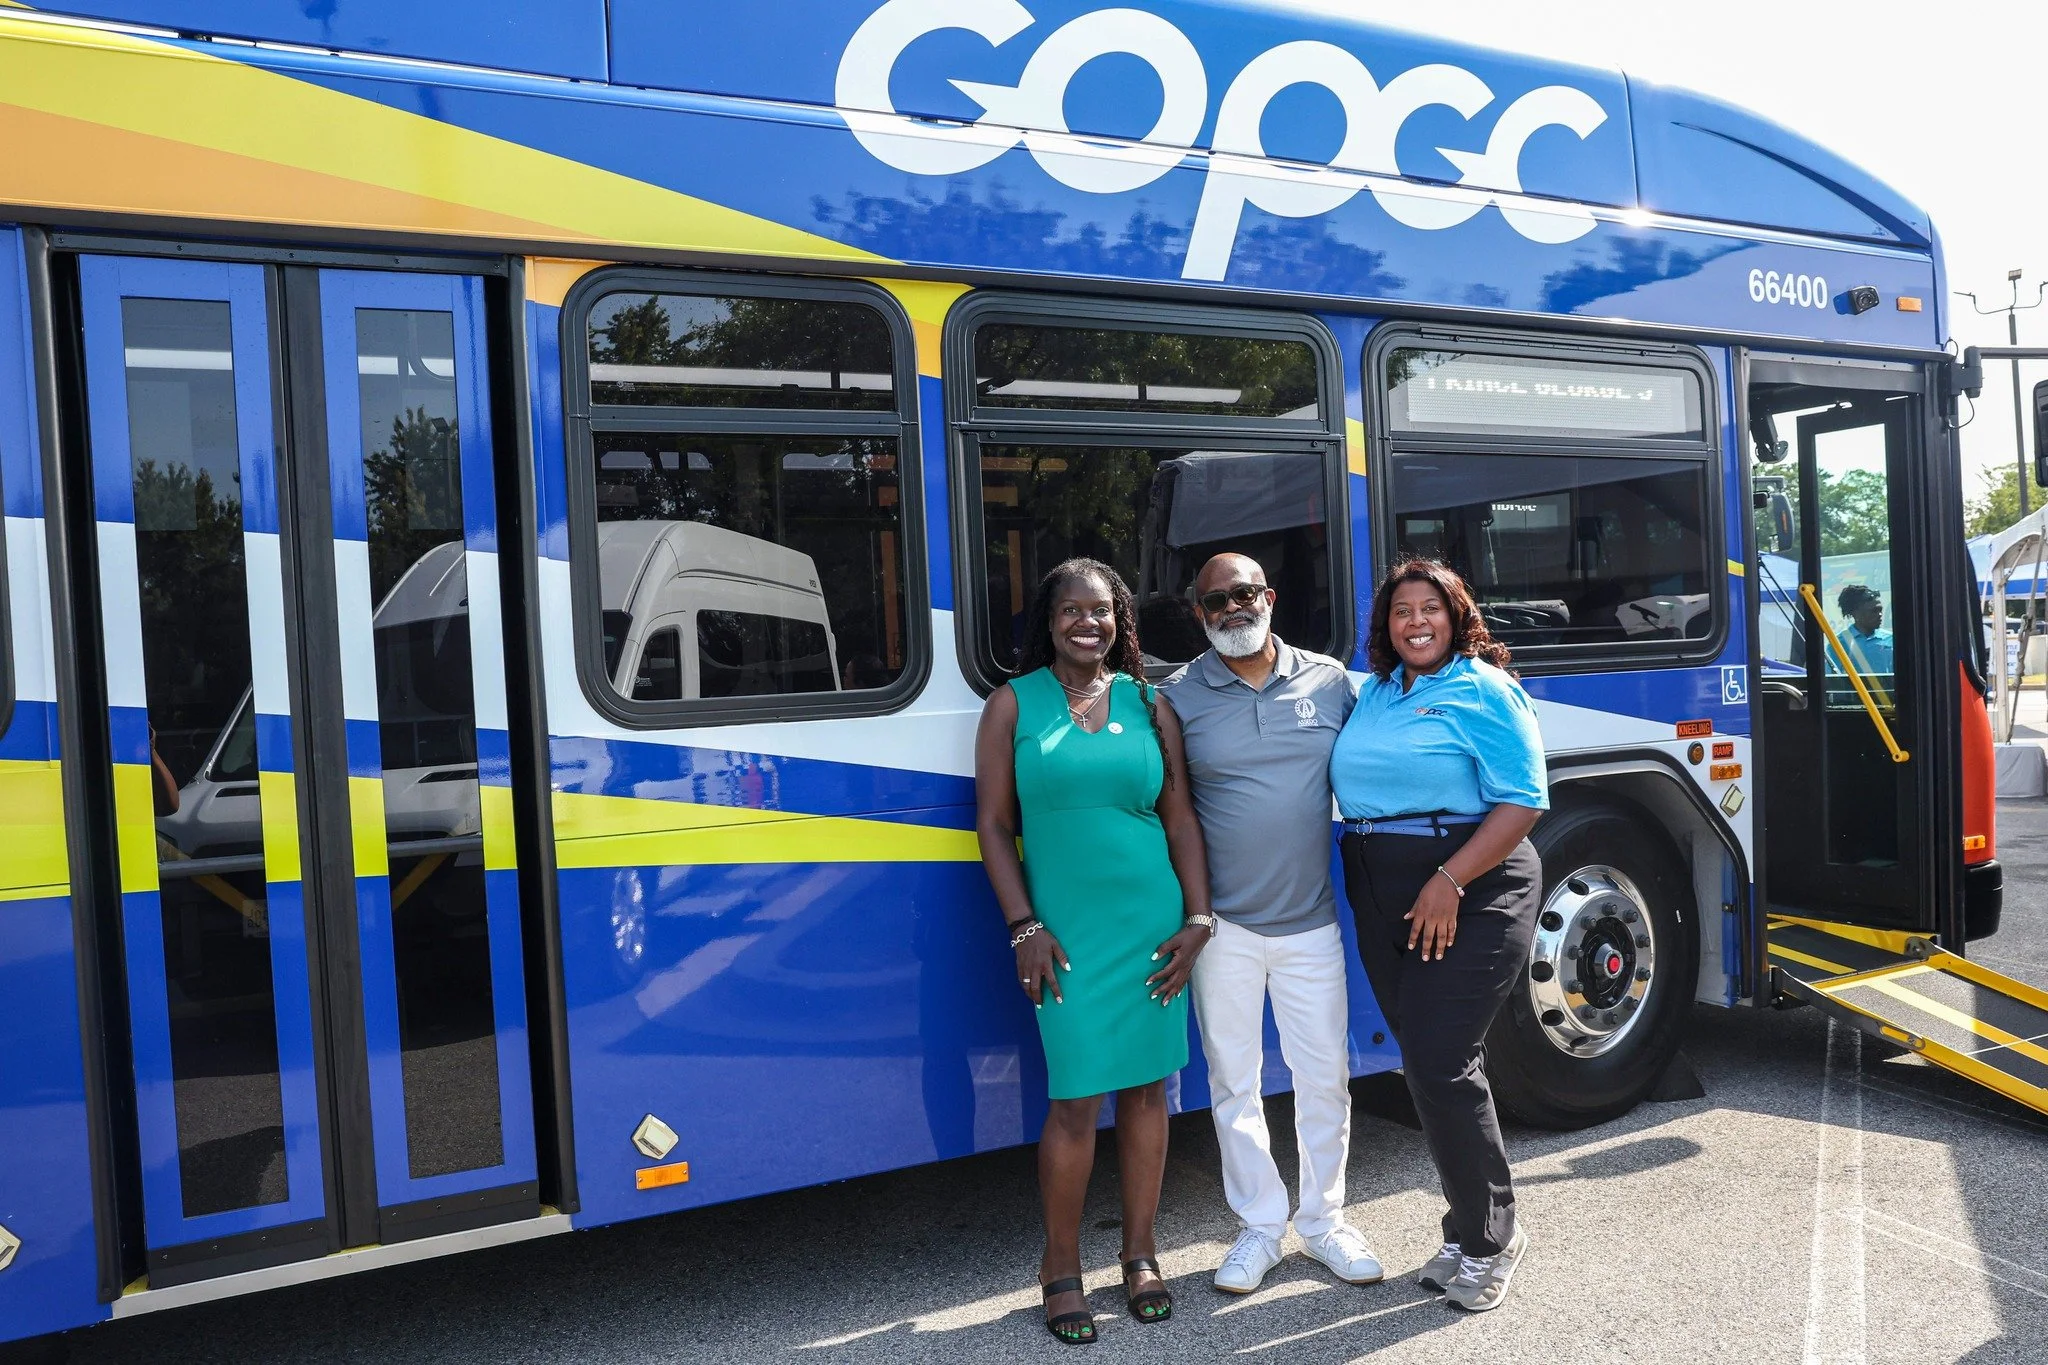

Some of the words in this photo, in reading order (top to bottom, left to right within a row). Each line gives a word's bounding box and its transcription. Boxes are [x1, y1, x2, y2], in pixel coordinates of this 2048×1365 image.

[1748, 268, 1828, 309] 66400
[1678, 722, 1710, 735] KNEELING
[1713, 745, 1733, 756] RAMP
